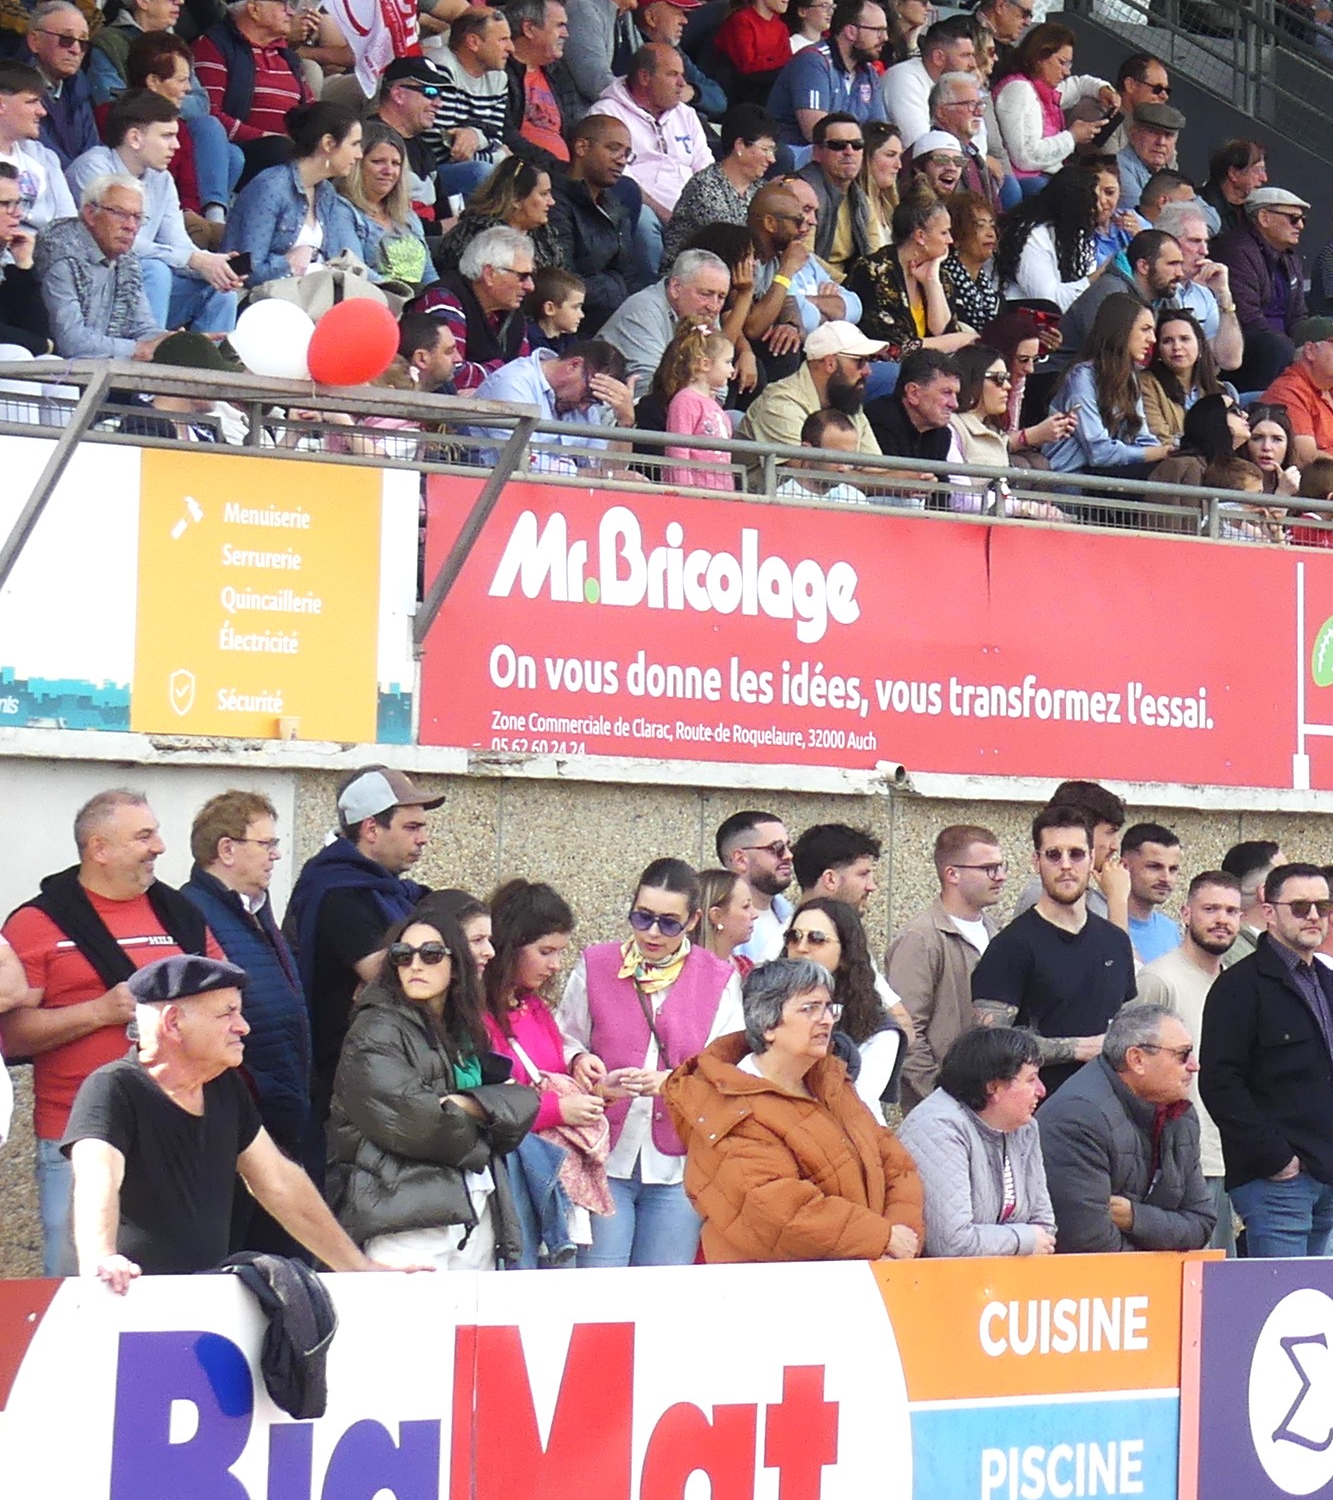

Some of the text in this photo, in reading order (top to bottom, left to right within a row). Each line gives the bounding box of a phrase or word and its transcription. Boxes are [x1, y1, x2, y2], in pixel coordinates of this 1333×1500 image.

[223, 501, 311, 531] Menuiserie
[222, 542, 302, 572] Serrurerie
[488, 505, 862, 644] Mr.Bricolage
[221, 585, 322, 616] Quincaillerie
[219, 621, 299, 654] Électricité
[217, 687, 284, 713] Sécurité
[489, 643, 1215, 731] On vous donne les idées, vous transformez l'essai.
[491, 710, 877, 752] Zone Commerciale de Clarac, Route de Roquelaure, 32000 Auch
[978, 1295, 1149, 1357] CUISINE
[981, 1439, 1144, 1500] PISCINE
